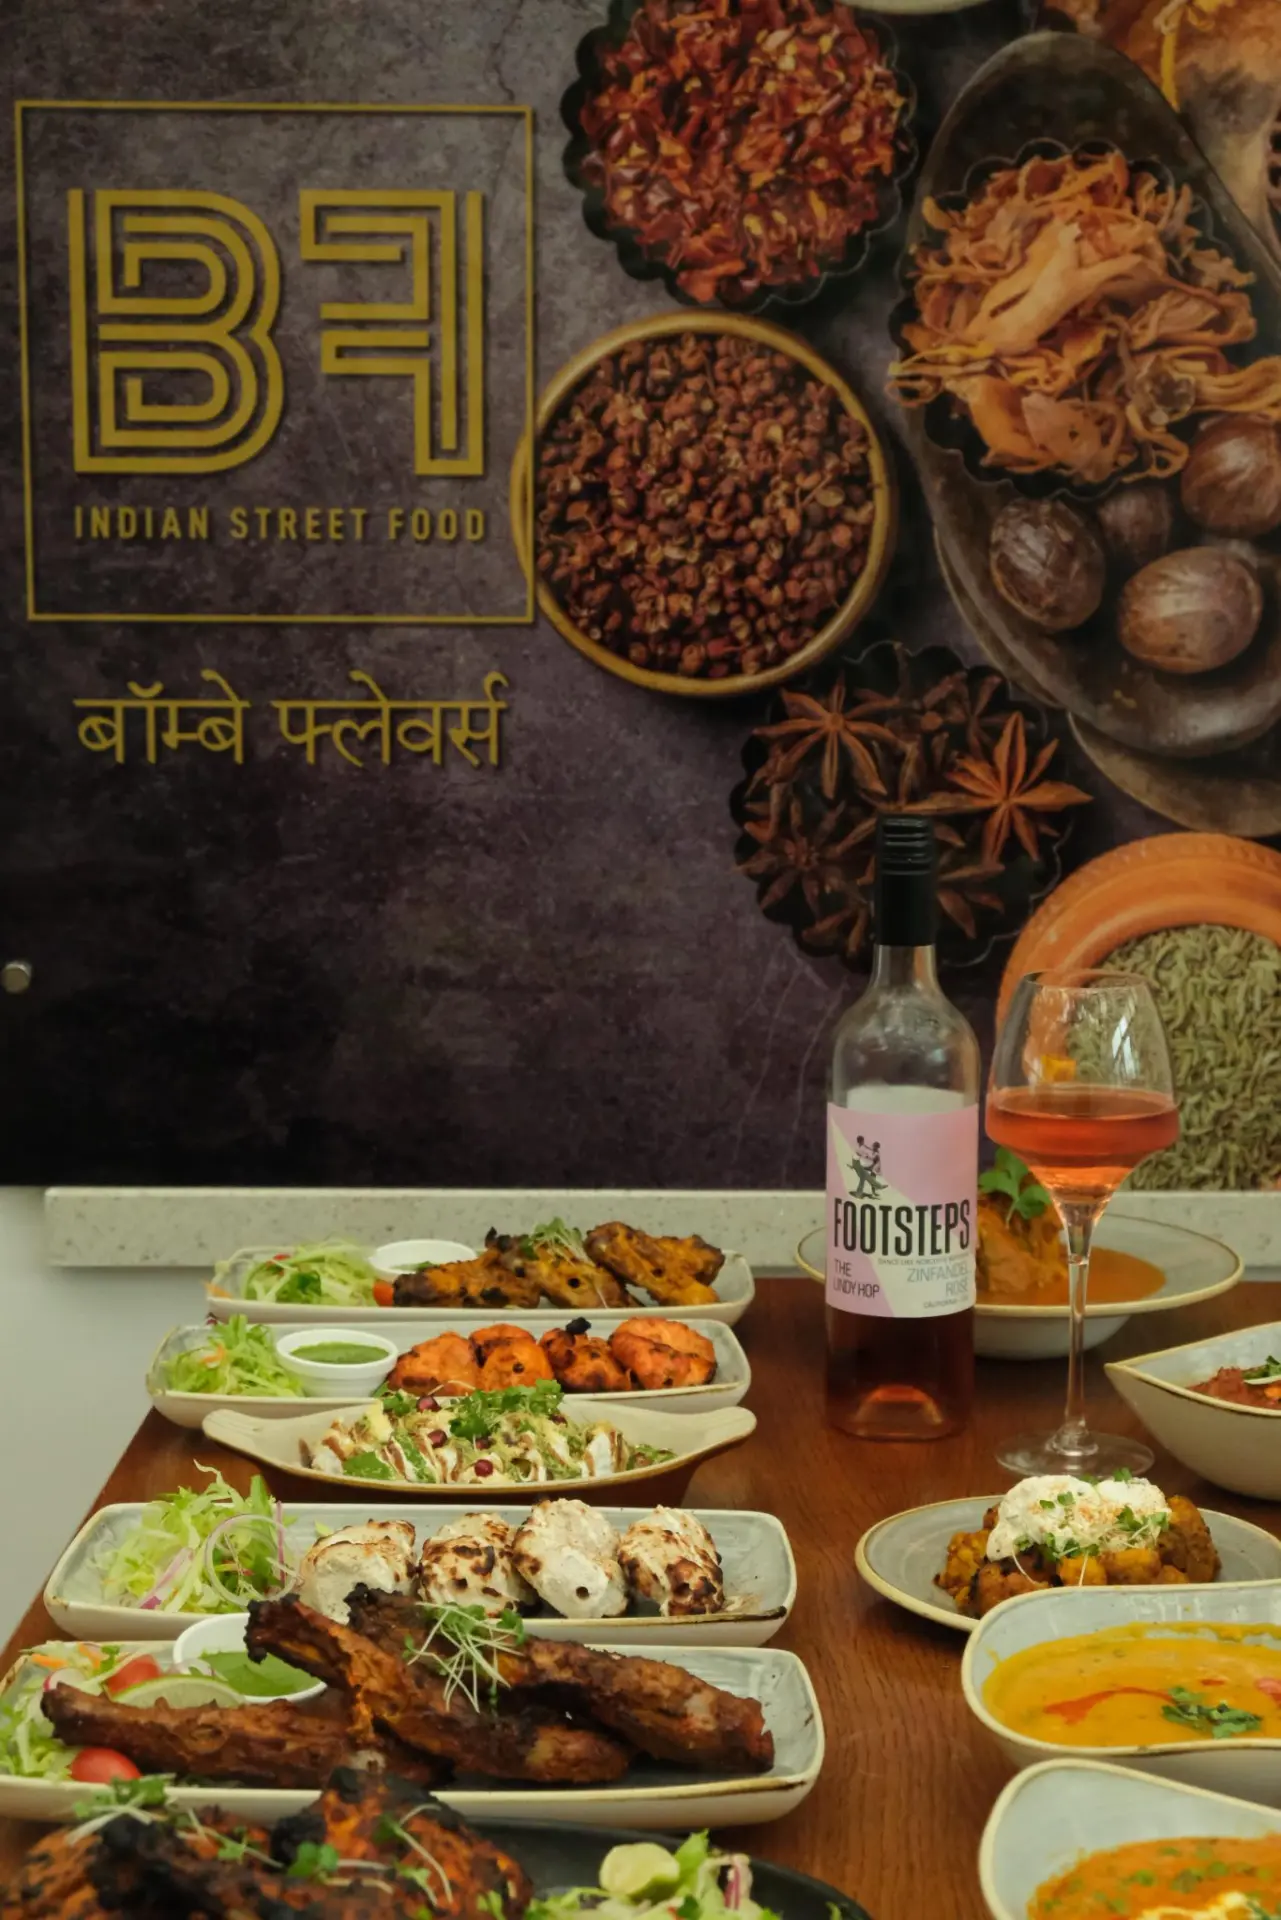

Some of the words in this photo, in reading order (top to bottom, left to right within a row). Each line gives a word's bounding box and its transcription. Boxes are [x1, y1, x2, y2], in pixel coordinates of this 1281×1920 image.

[74, 507, 208, 539] INDIAN
[229, 507, 367, 539] STREET
[388, 508, 486, 540] FOOD
[73, 669, 251, 765] बॉम्बे
[271, 671, 509, 767] फ्लेवर्स
[834, 1198, 970, 1256] FOOTSTEPS
[834, 1258, 852, 1277] THE
[833, 1276, 857, 1296] LINDY
[858, 1283, 880, 1299] HOP
